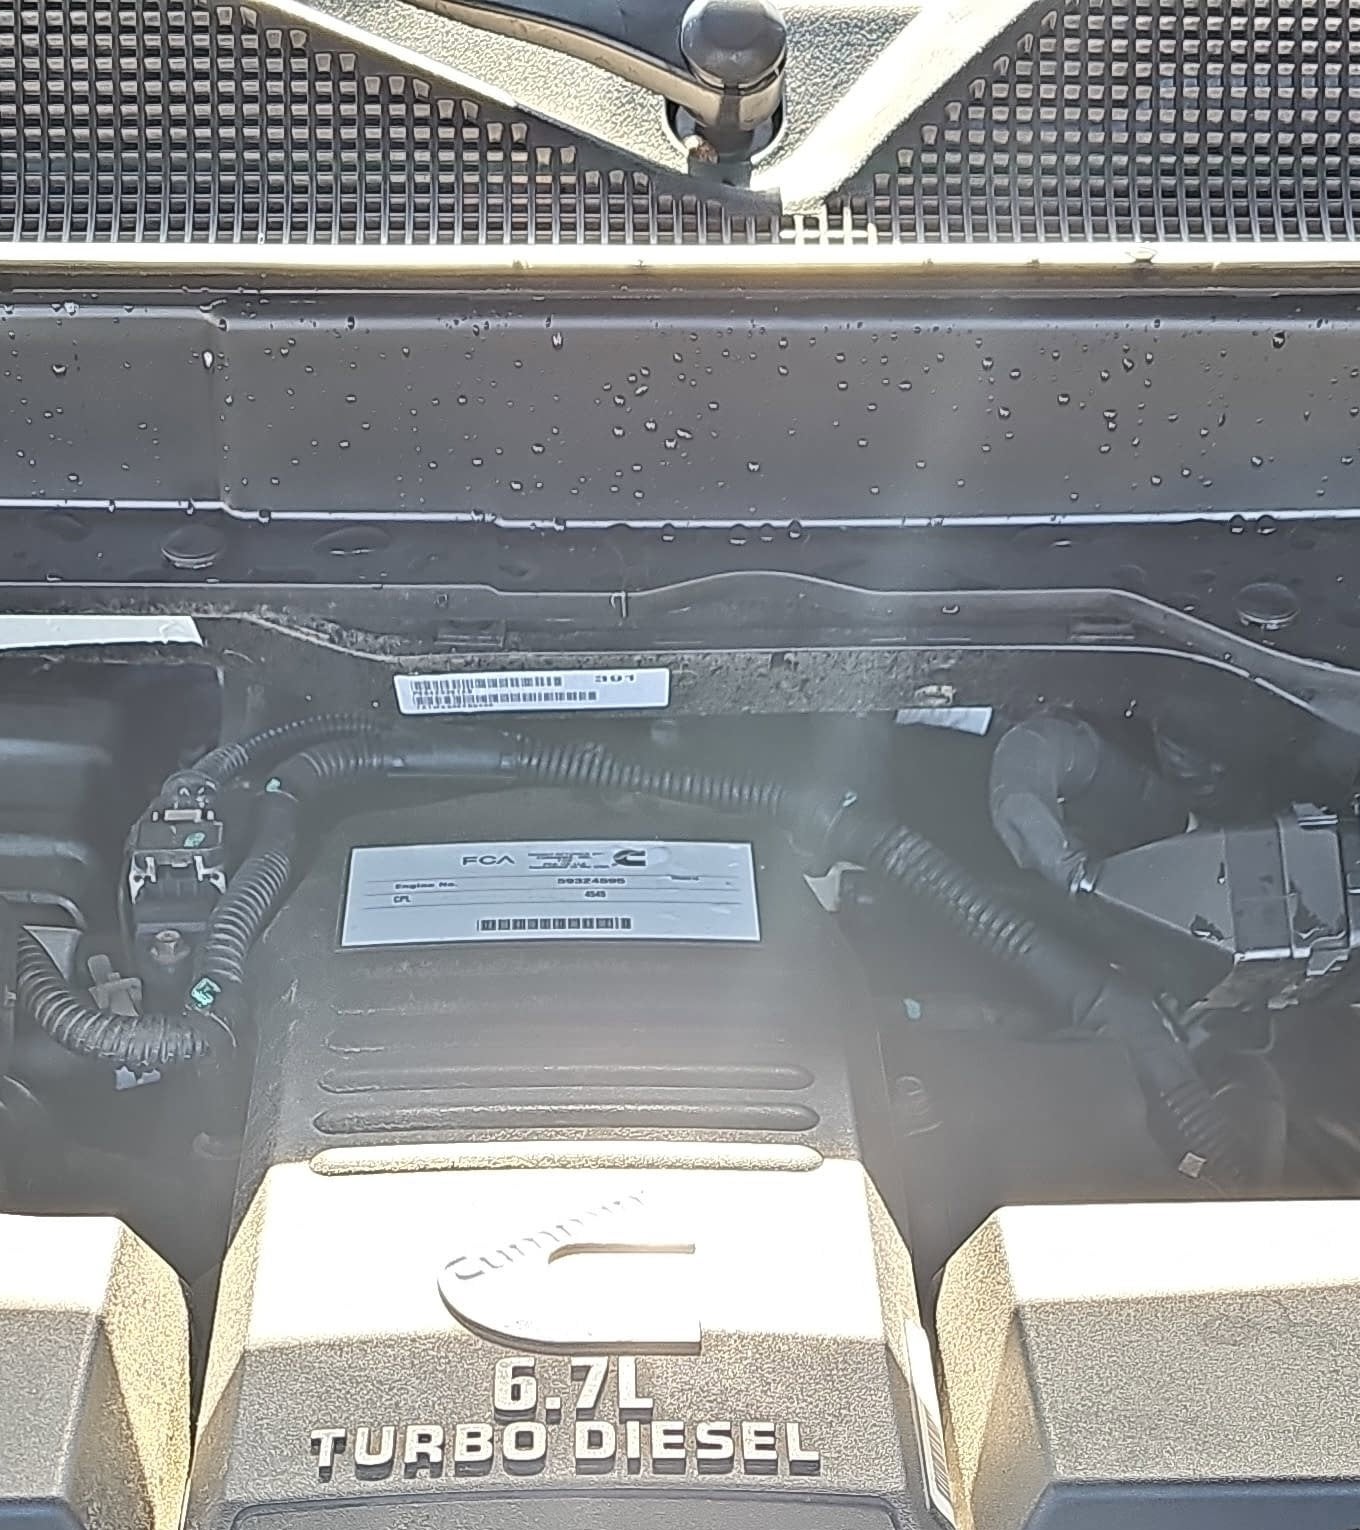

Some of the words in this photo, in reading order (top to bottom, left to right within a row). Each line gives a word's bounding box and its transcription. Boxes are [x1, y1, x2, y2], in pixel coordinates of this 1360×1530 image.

[462, 854, 515, 866] FCA
[492, 1355, 654, 1421] 6.7L
[310, 1422, 549, 1482] TURBO
[574, 1421, 822, 1478] DIESEL
